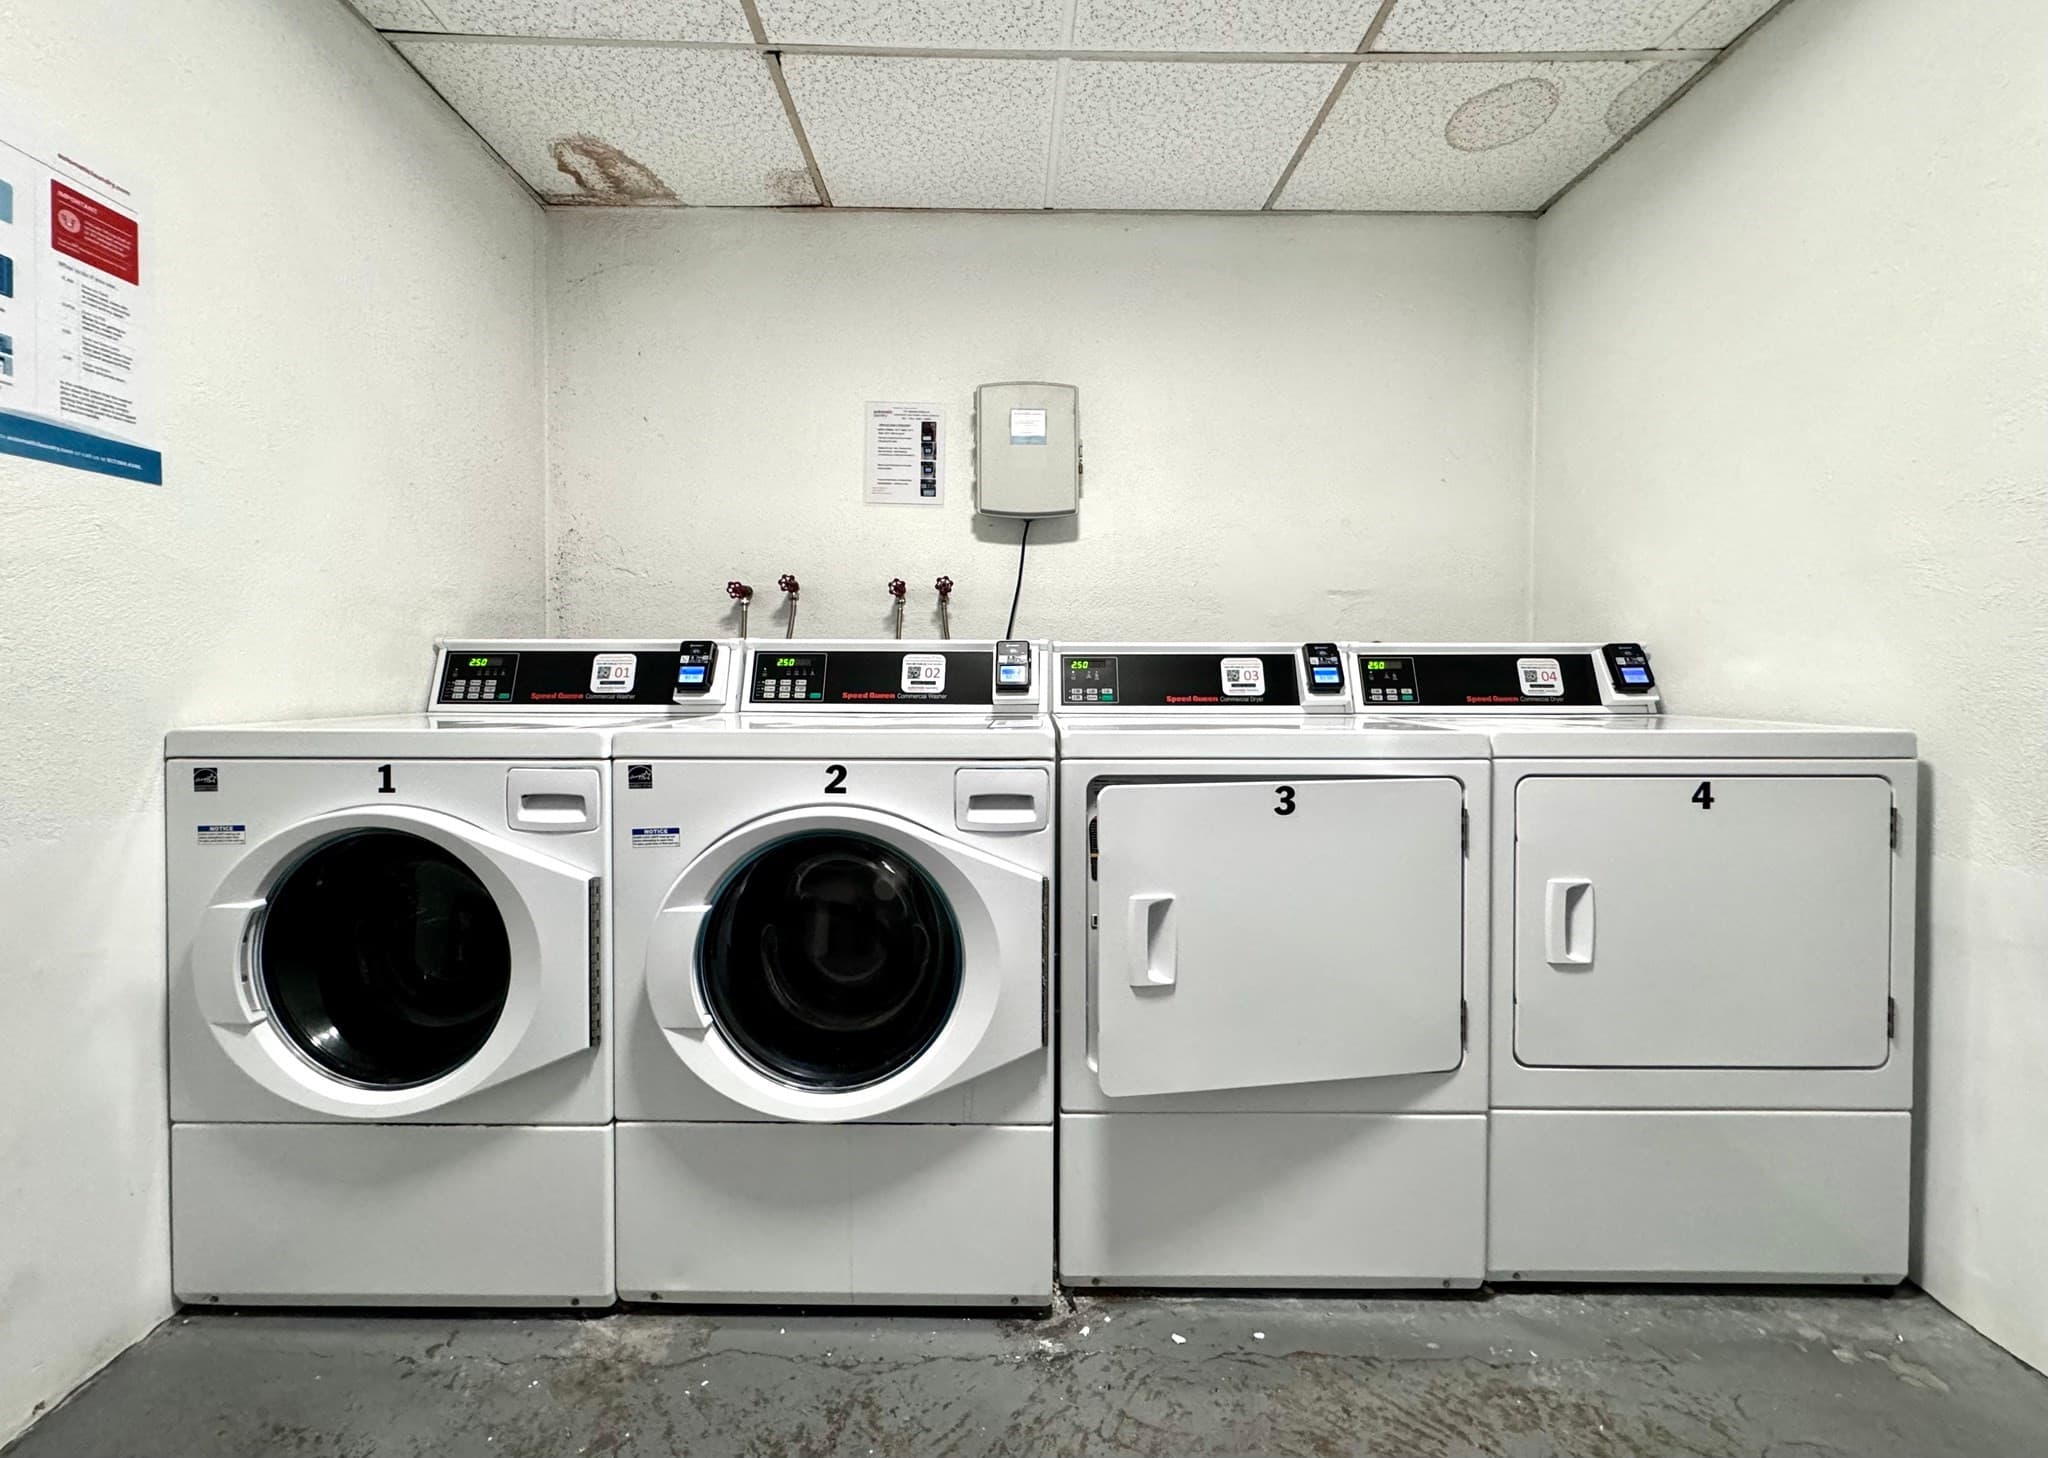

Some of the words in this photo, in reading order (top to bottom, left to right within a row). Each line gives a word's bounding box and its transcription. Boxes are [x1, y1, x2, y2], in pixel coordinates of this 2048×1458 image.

[614, 667, 630, 678] 01
[924, 667, 941, 679] 02
[1243, 670, 1260, 681] 03
[1541, 671, 1558, 682] 04
[531, 692, 557, 700] Speed
[558, 692, 584, 700] Queen
[842, 692, 868, 700] Speed
[869, 692, 896, 700] Queen
[1166, 695, 1192, 703] Speed
[1193, 695, 1219, 703] Queen
[1466, 695, 1492, 703] Speed
[1493, 695, 1519, 703] Queen
[378, 764, 396, 793] 1
[824, 764, 848, 794] 2
[1274, 785, 1296, 816] 3
[1691, 781, 1715, 810] 4
